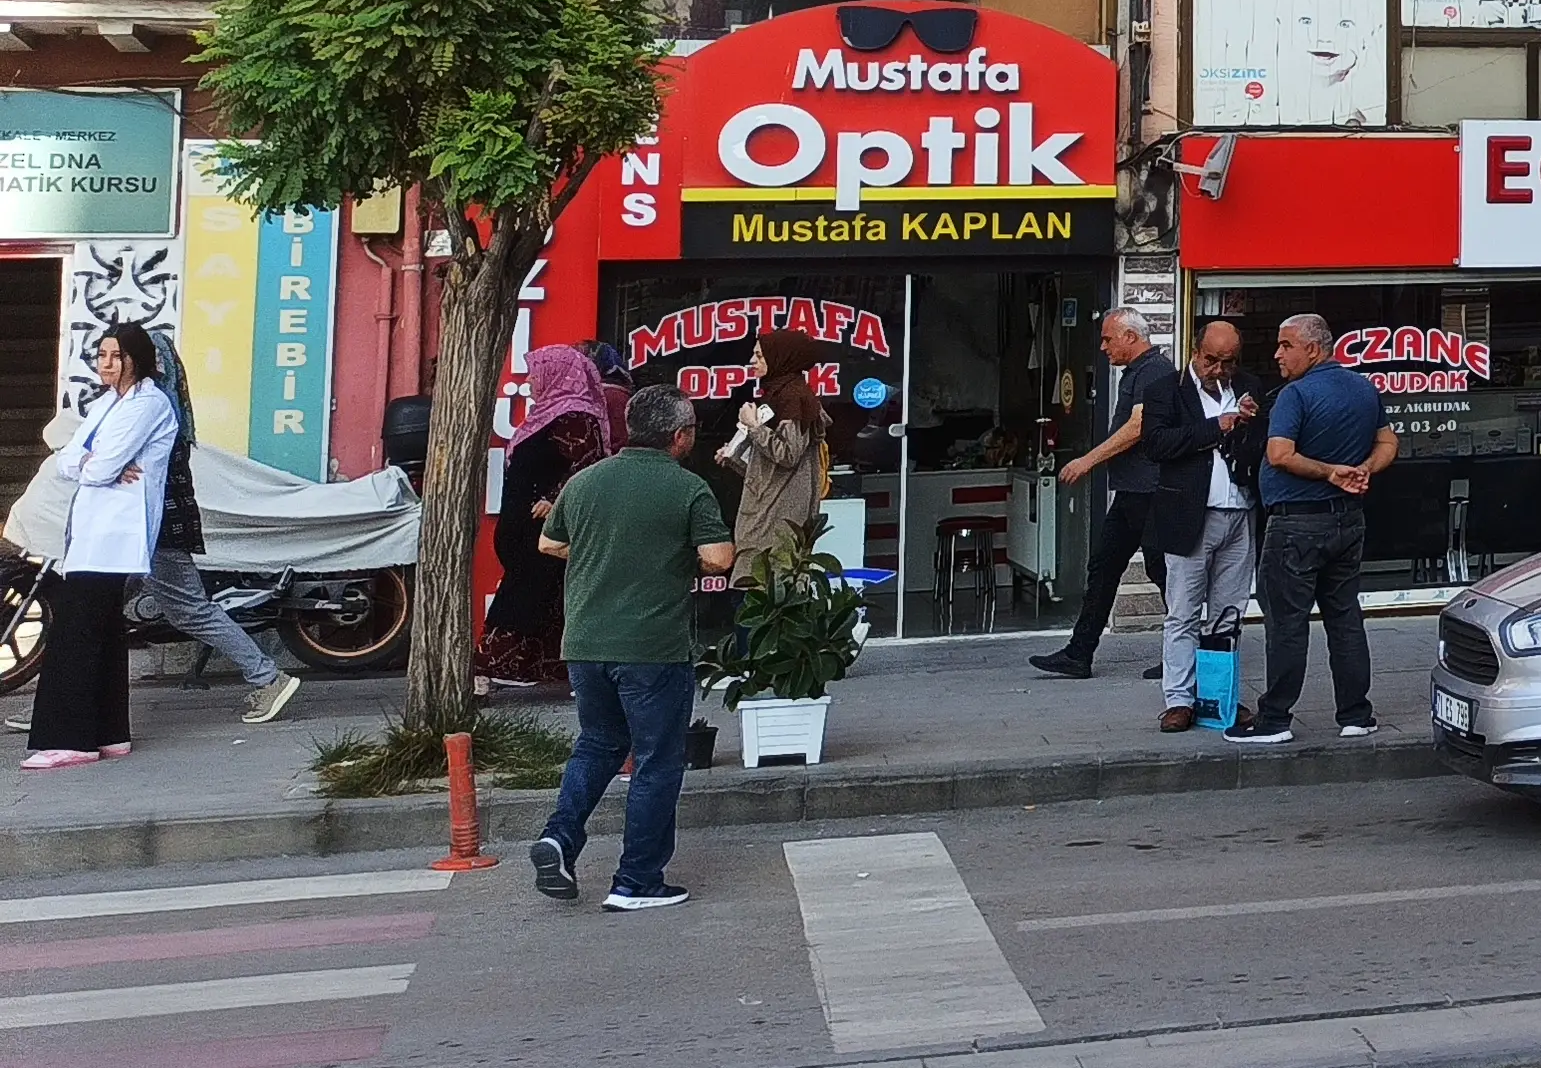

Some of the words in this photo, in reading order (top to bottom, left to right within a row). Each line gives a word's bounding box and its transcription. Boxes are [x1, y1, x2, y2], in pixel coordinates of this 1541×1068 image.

[792, 47, 1019, 92] Mustafa
[56, 131, 116, 141] MERKEZ
[50, 153, 101, 169] DNA
[718, 101, 1084, 211] Optik
[71, 177, 157, 193] KURSU
[732, 212, 886, 243] Mustafa
[902, 211, 1071, 241] KAPLAN
[273, 205, 315, 435] BİREBİR
[629, 297, 890, 369] MUSTAFA
[1404, 402, 1470, 413] AKBUDAK
